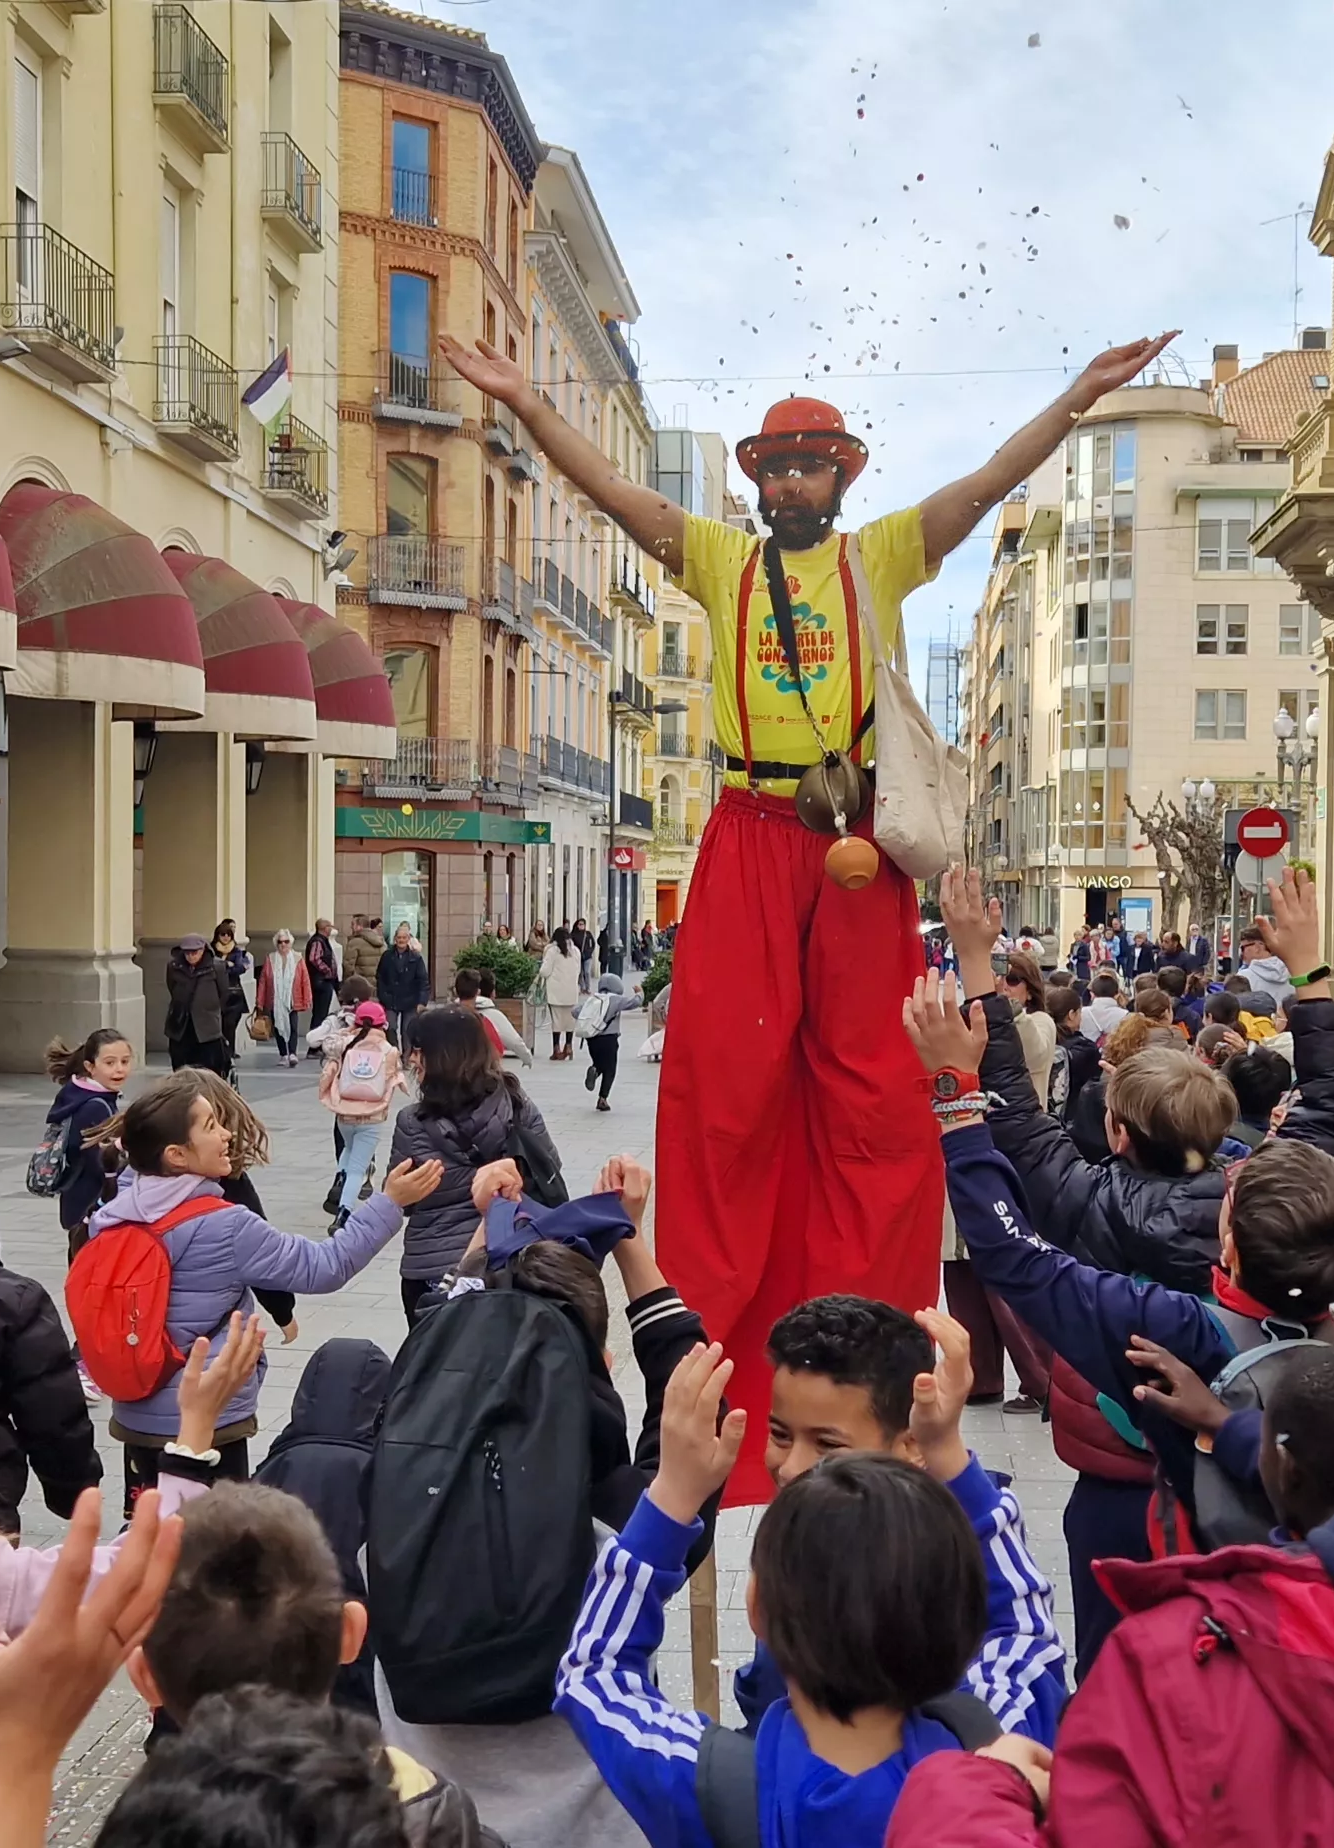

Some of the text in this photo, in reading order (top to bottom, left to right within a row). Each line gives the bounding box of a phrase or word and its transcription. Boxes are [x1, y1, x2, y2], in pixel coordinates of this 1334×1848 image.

[759, 630, 835, 649] LA RTE DE
[757, 646, 835, 665] CONRNOS
[1076, 875, 1132, 889] MANGO
